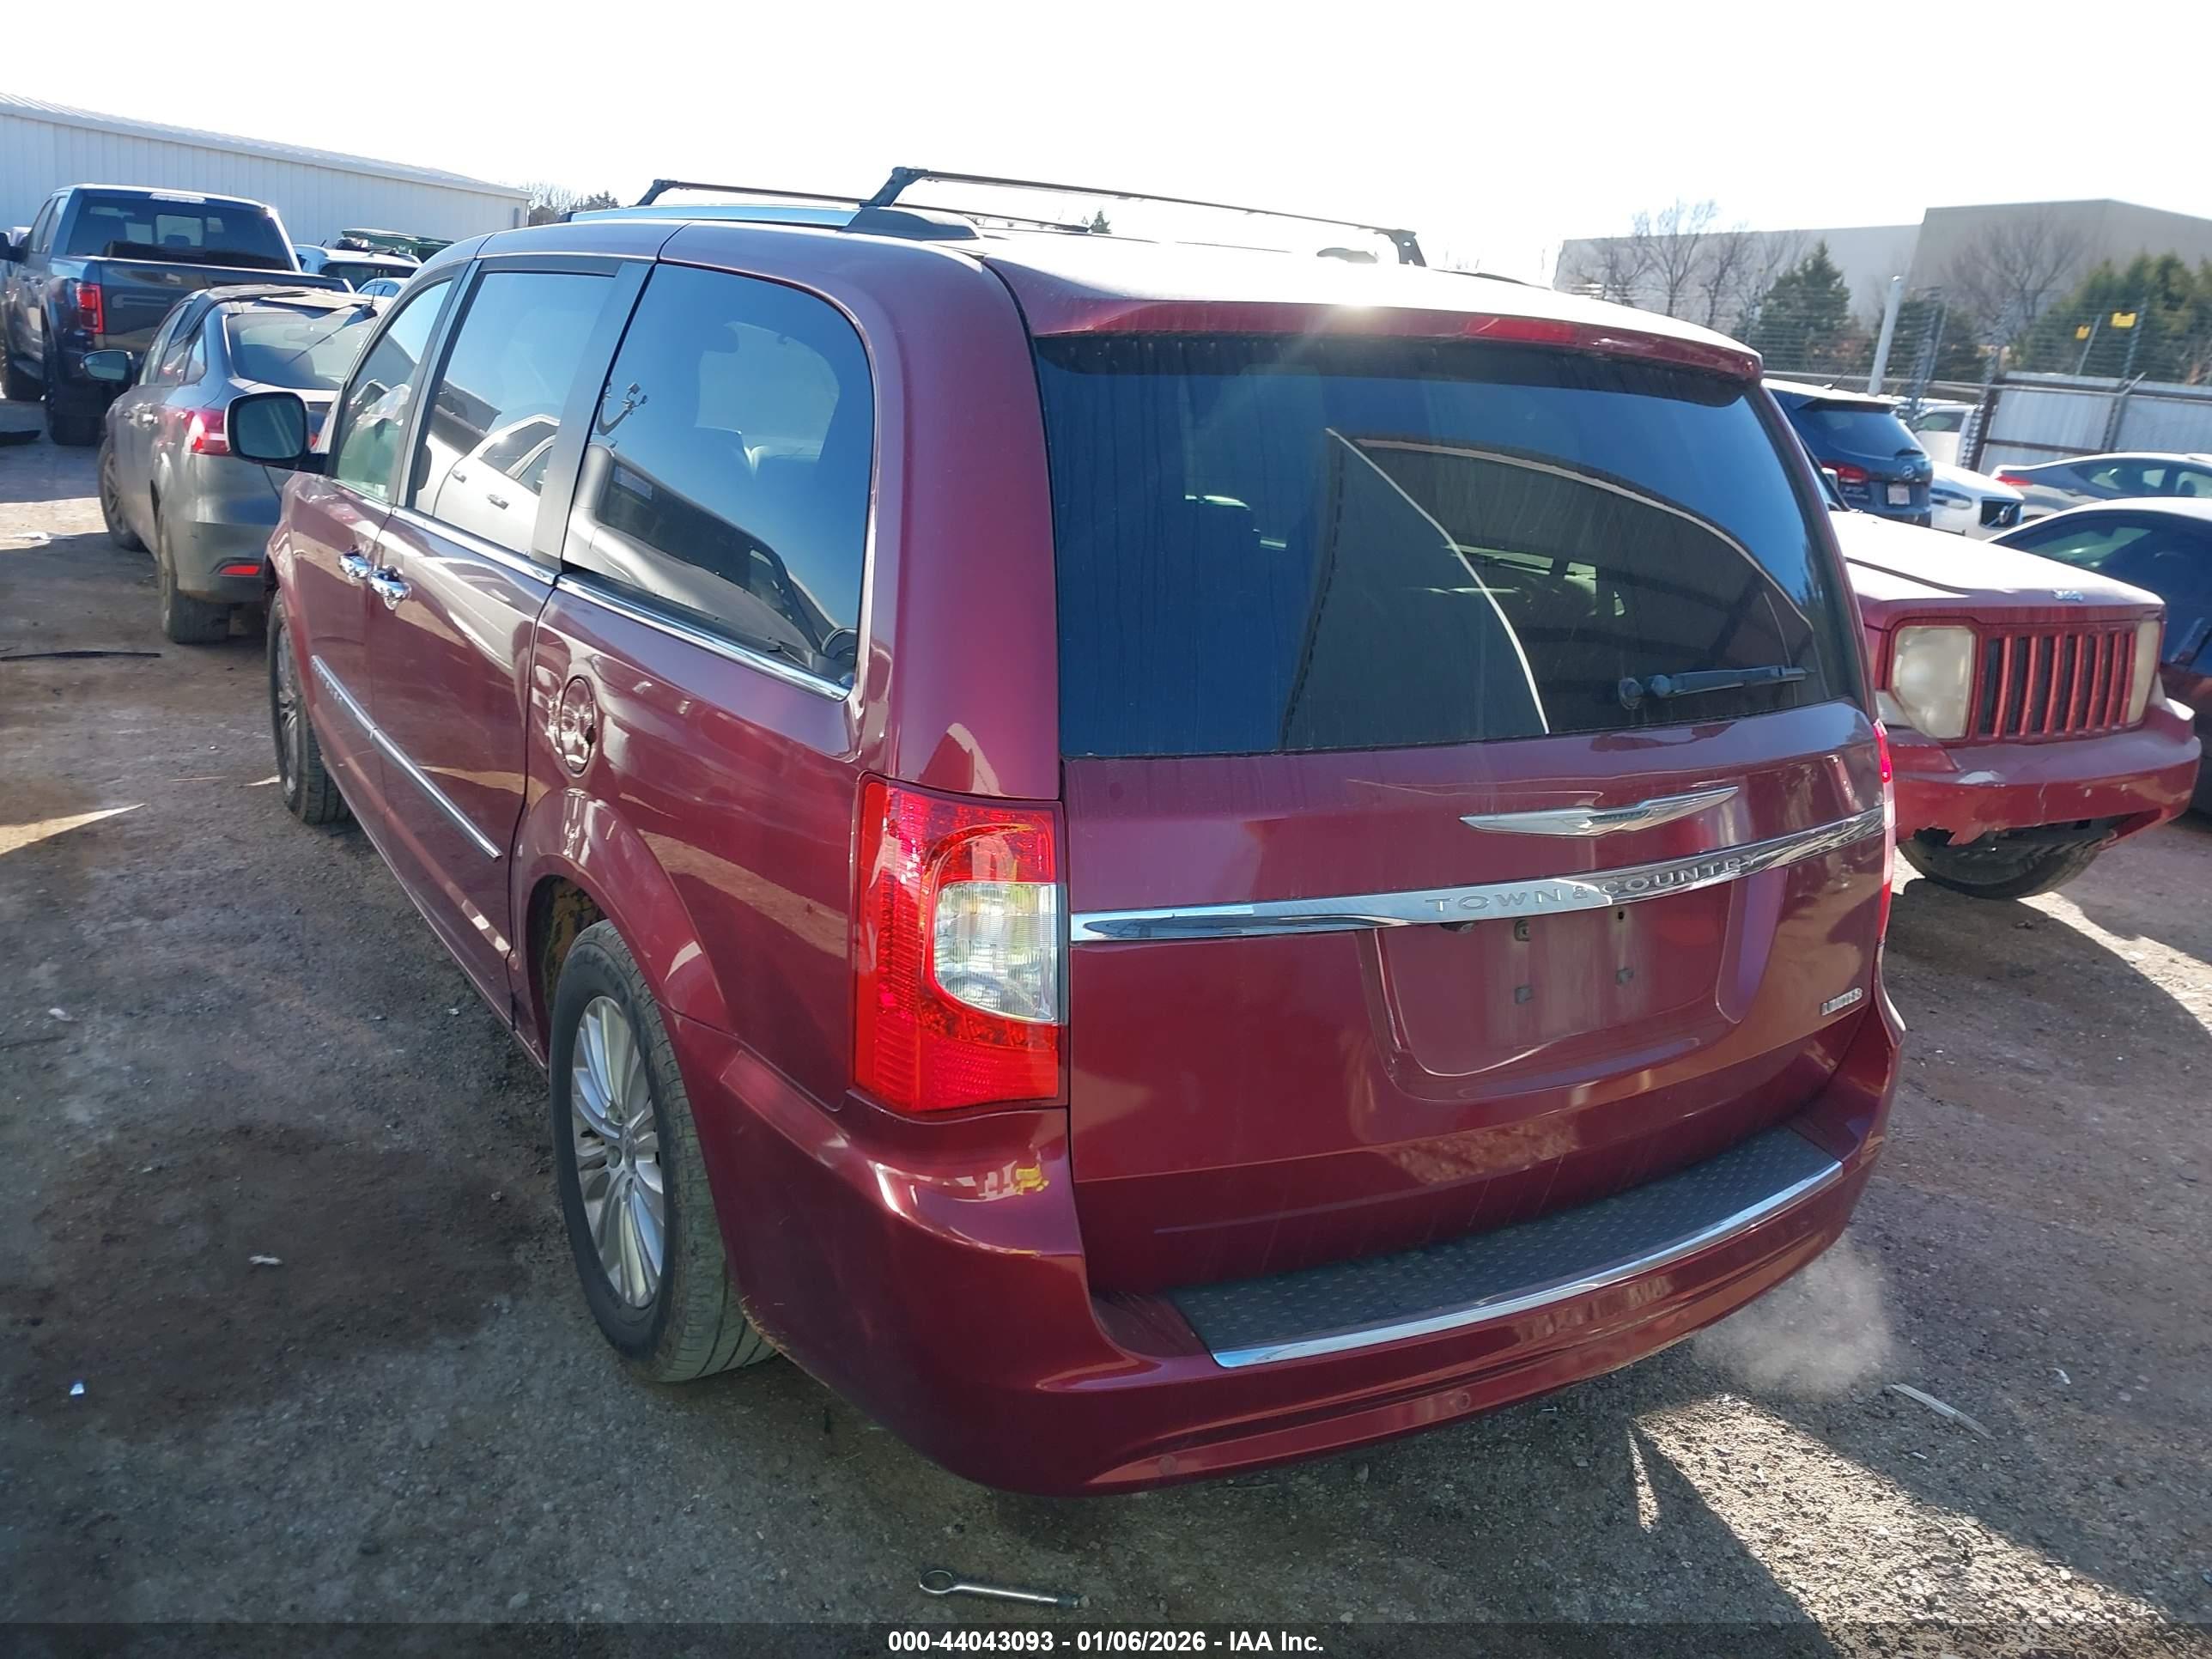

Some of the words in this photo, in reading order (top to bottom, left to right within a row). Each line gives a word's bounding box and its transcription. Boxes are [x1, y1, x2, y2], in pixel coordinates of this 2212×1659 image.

[1425, 888, 1562, 913] TOWN
[1572, 884, 1589, 900] &
[1600, 852, 1761, 896] COUNTRY
